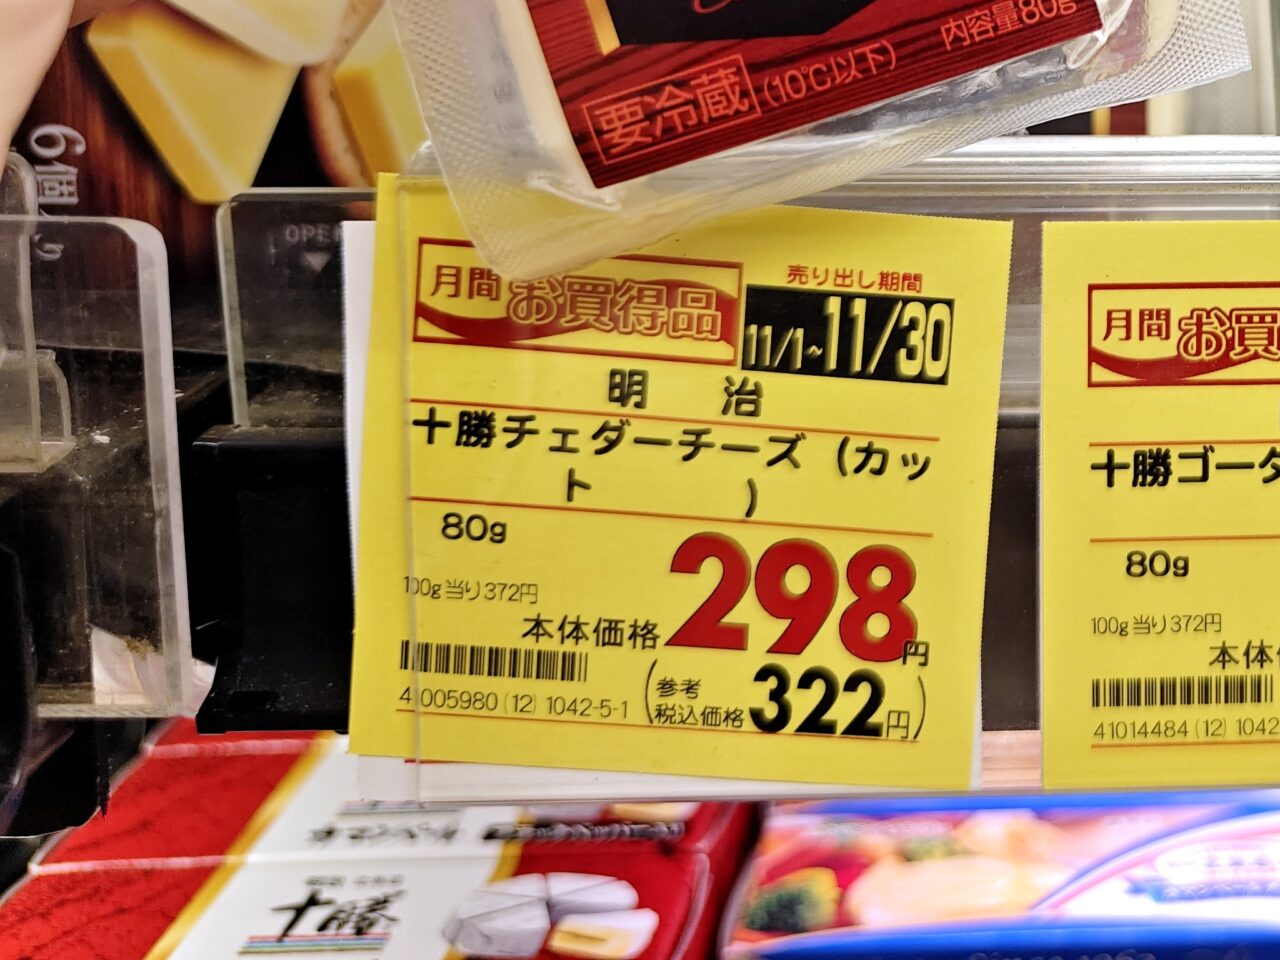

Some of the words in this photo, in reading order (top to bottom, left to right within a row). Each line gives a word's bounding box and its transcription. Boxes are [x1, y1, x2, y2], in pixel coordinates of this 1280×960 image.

[594, 70, 750, 152] 要冷蔵
[786, 263, 924, 294] 売り出し期間
[430, 264, 501, 302] 月間
[506, 274, 723, 341] お買得品
[1102, 308, 1172, 341] 月間
[441, 512, 507, 545] 80g
[1125, 550, 1190, 579] 80g
[522, 612, 662, 650] 本体価格
[1090, 613, 1223, 638] 100g当り372円
[656, 676, 702, 700] 参考
[547, 696, 629, 721] 1042-5-1
[654, 702, 746, 730] 税込価格
[1093, 716, 1190, 741] 41014484
